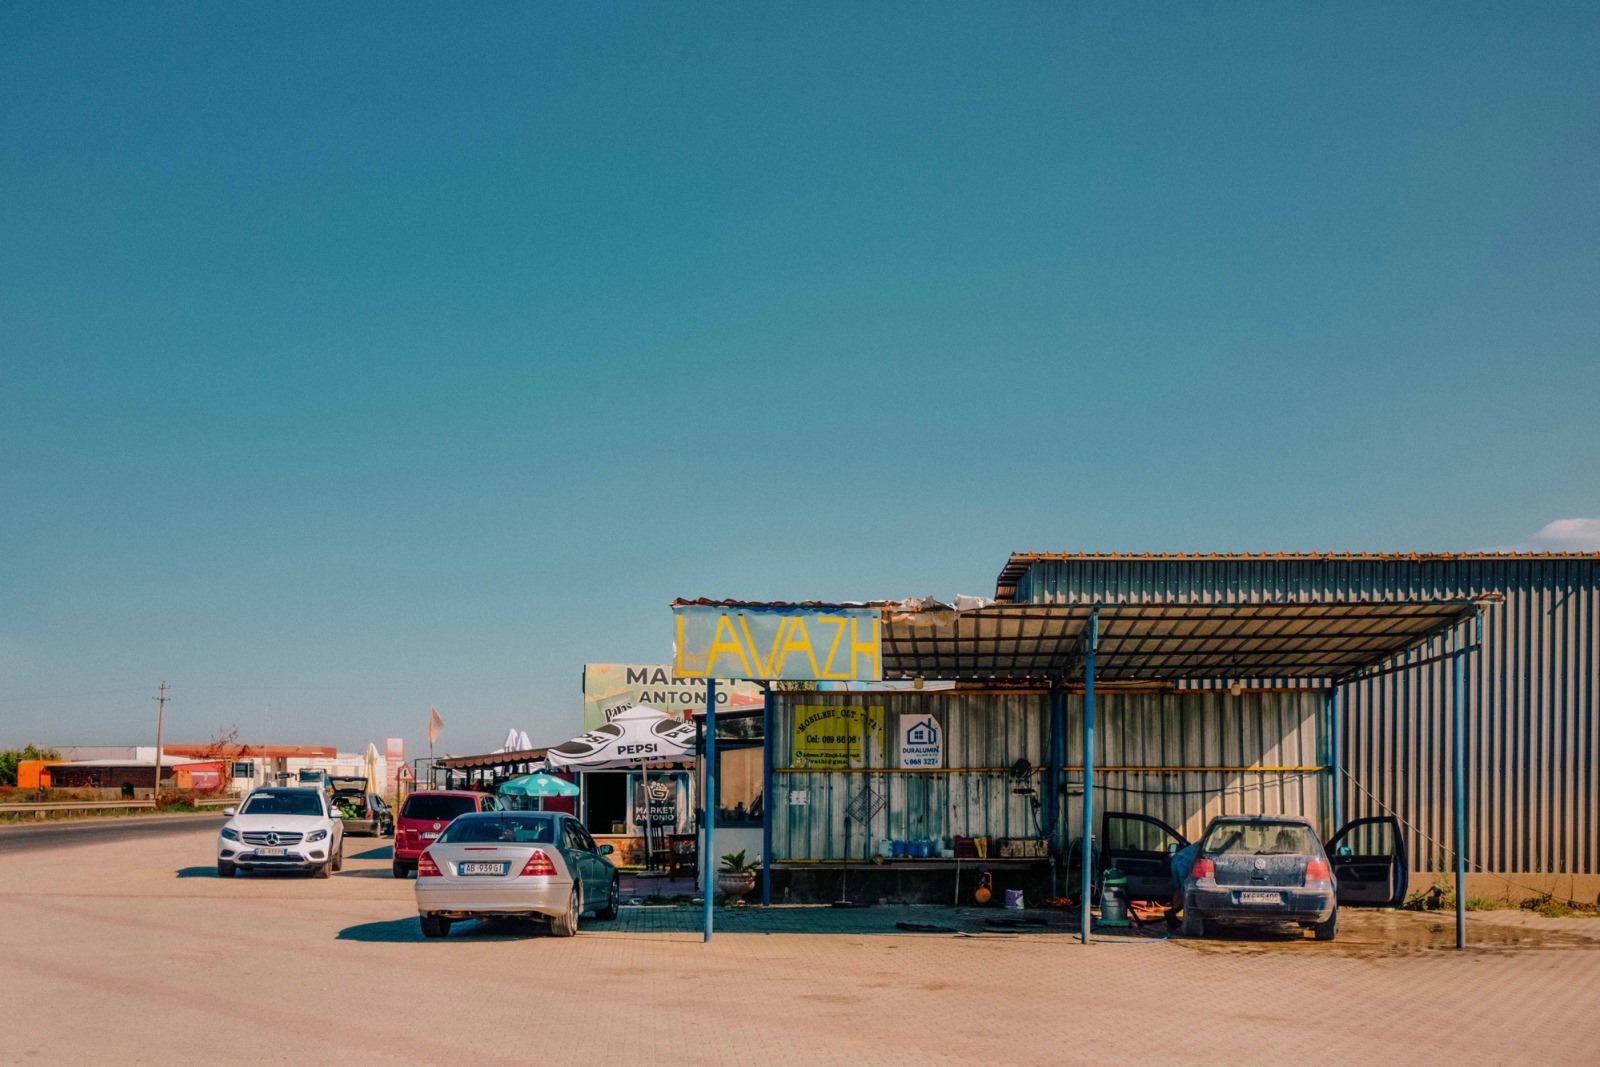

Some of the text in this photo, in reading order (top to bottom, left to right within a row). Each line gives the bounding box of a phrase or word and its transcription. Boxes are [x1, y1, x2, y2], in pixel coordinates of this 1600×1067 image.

[676, 613, 879, 678] LAVAZH
[638, 691, 728, 704] ANTONO
[617, 743, 658, 755] PEPSI
[466, 864, 475, 872] AB
